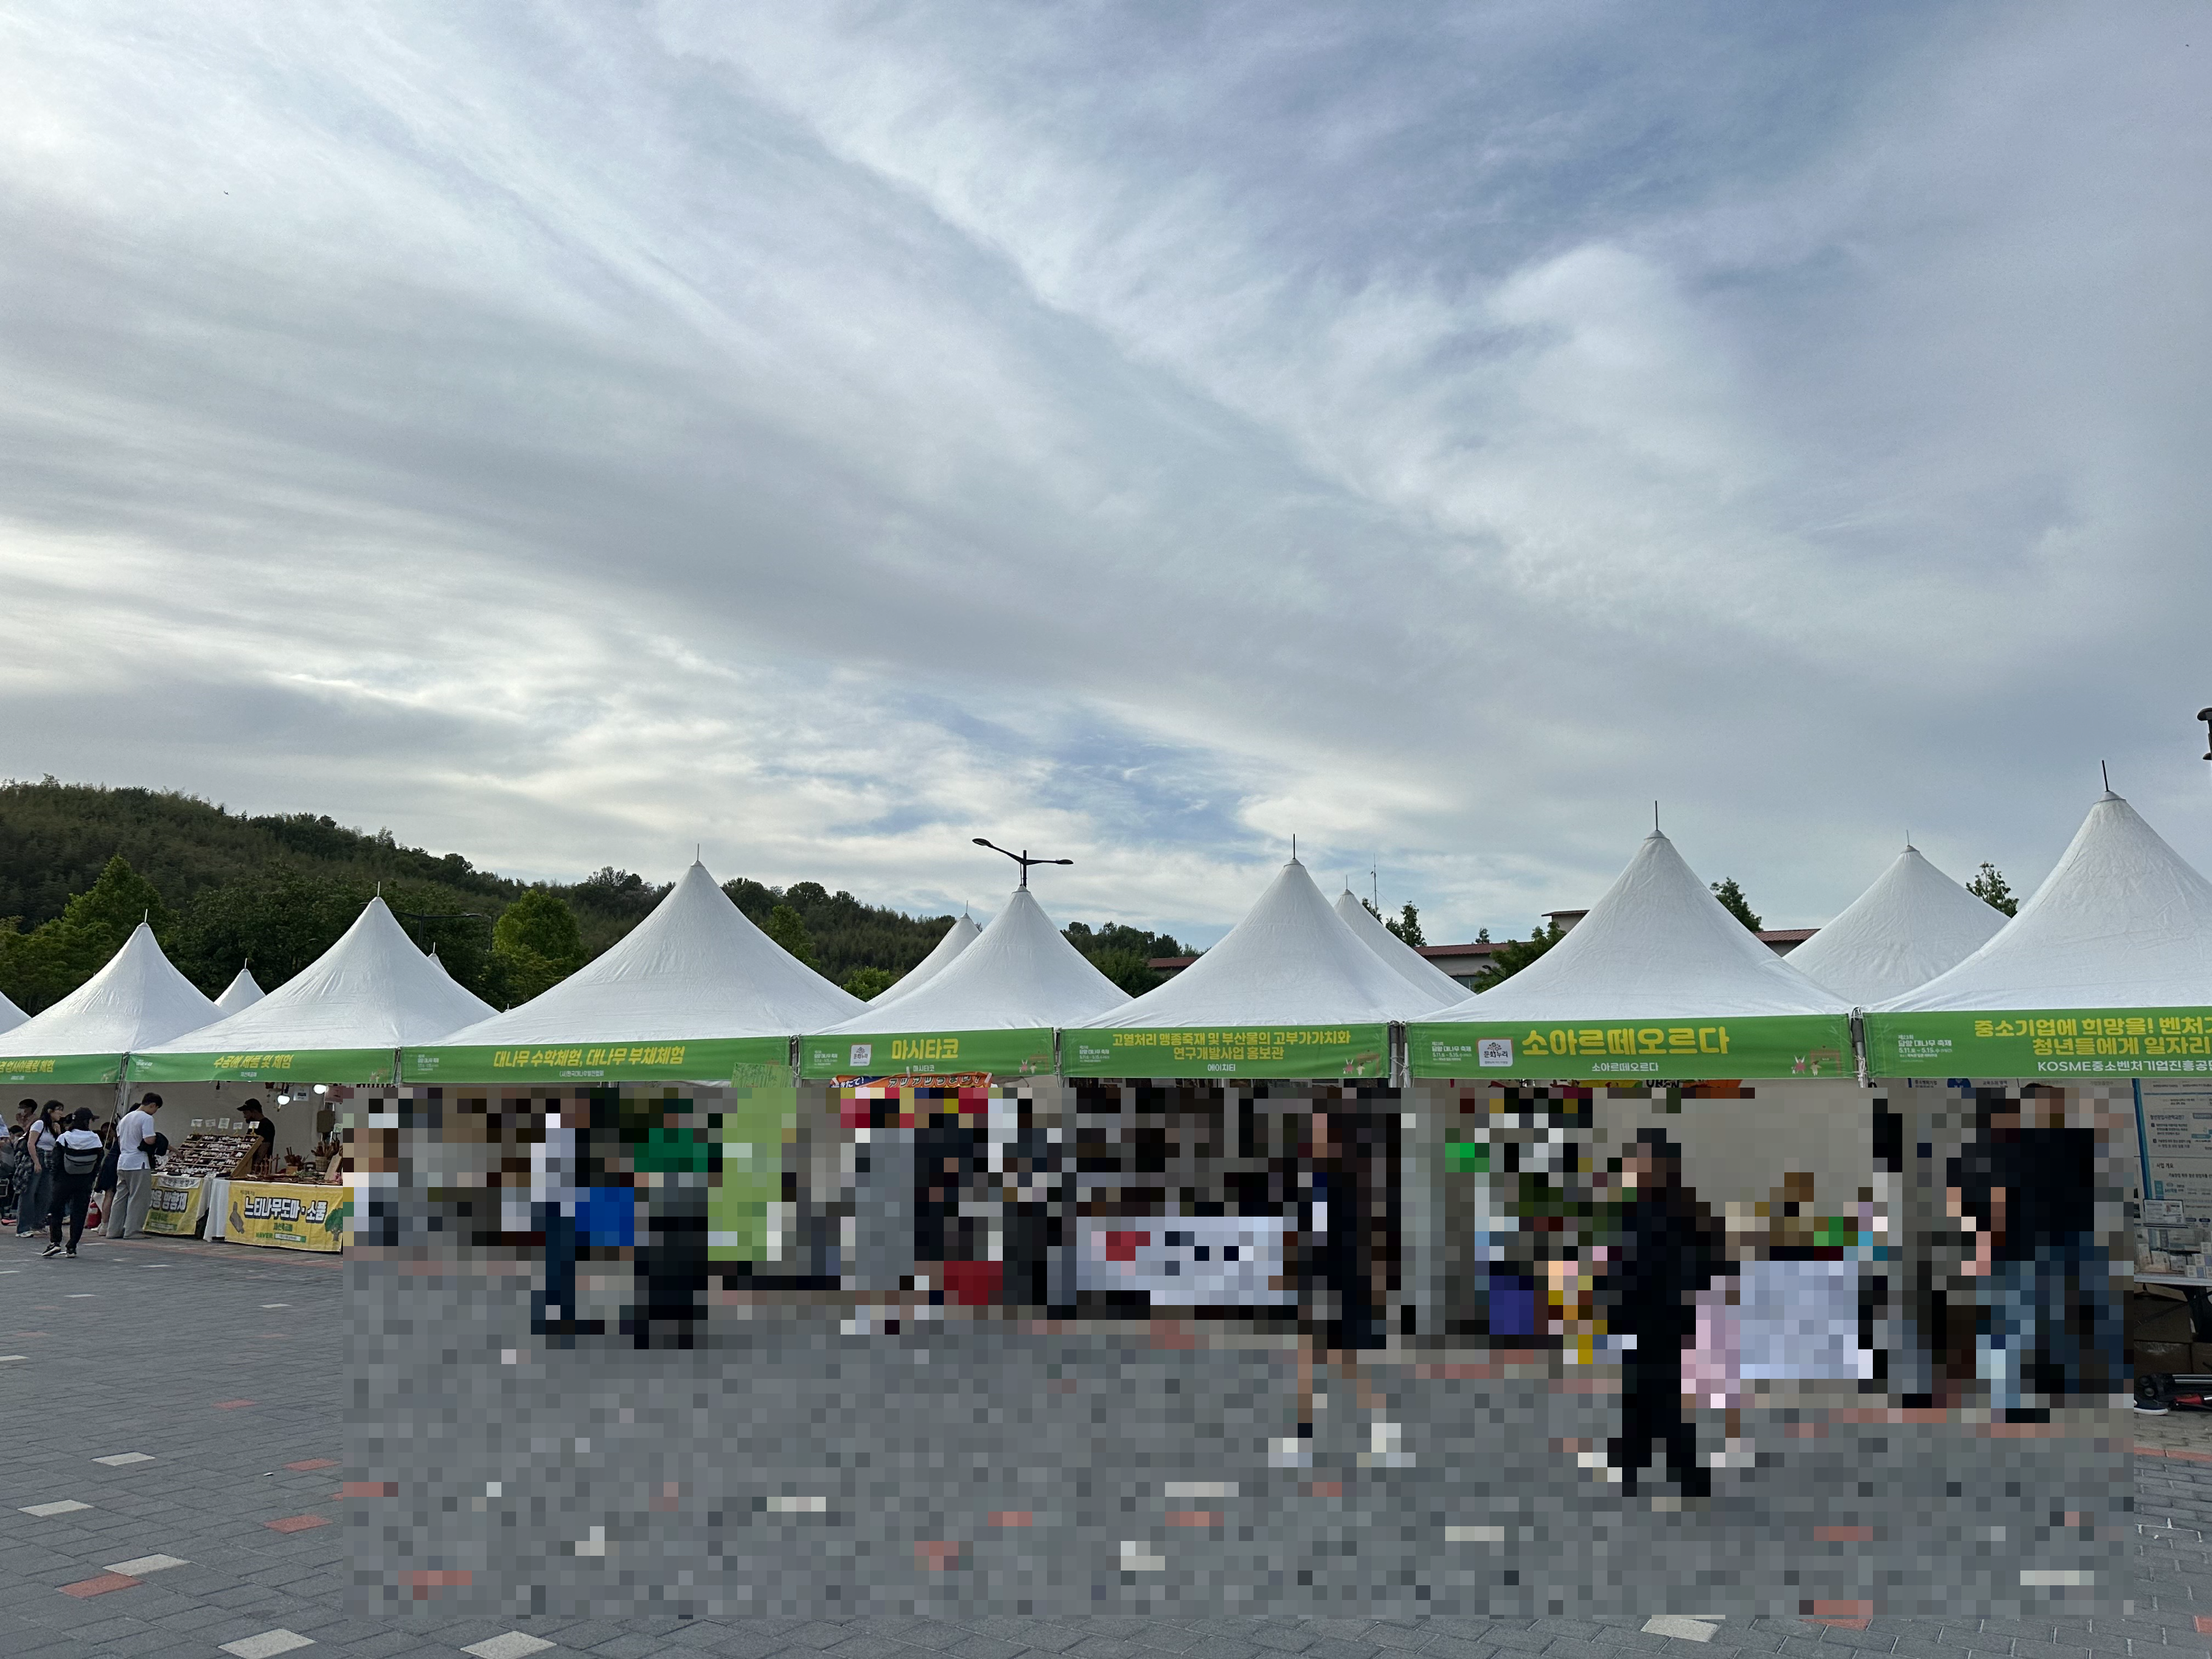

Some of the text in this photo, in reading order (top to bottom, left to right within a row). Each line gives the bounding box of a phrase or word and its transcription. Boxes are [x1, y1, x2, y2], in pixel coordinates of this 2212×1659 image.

[1975, 1018, 2077, 1037] 중소기업에
[2081, 1017, 2154, 1036] 희망을!
[1112, 1030, 1351, 1046] 고열처리 맹종죽재 및 부산물의 고부가가치화
[1522, 1026, 1730, 1055] 소아르떼오르다
[2033, 1037, 2139, 1056] 청년들에게
[493, 1046, 686, 1068] 대나무 수학체험, 대나무 부채체험
[891, 1038, 959, 1060] 마시타코
[1173, 1046, 1284, 1060] 연구개발사업 홍보관
[39, 1060, 56, 1073] 체험
[261, 1054, 274, 1068] 및
[271, 1054, 295, 1069] 체험
[1207, 1063, 1236, 1072] 에이치티
[1592, 1062, 1659, 1072] 소아르떼오르다
[151, 1189, 188, 1211] 용 방향제
